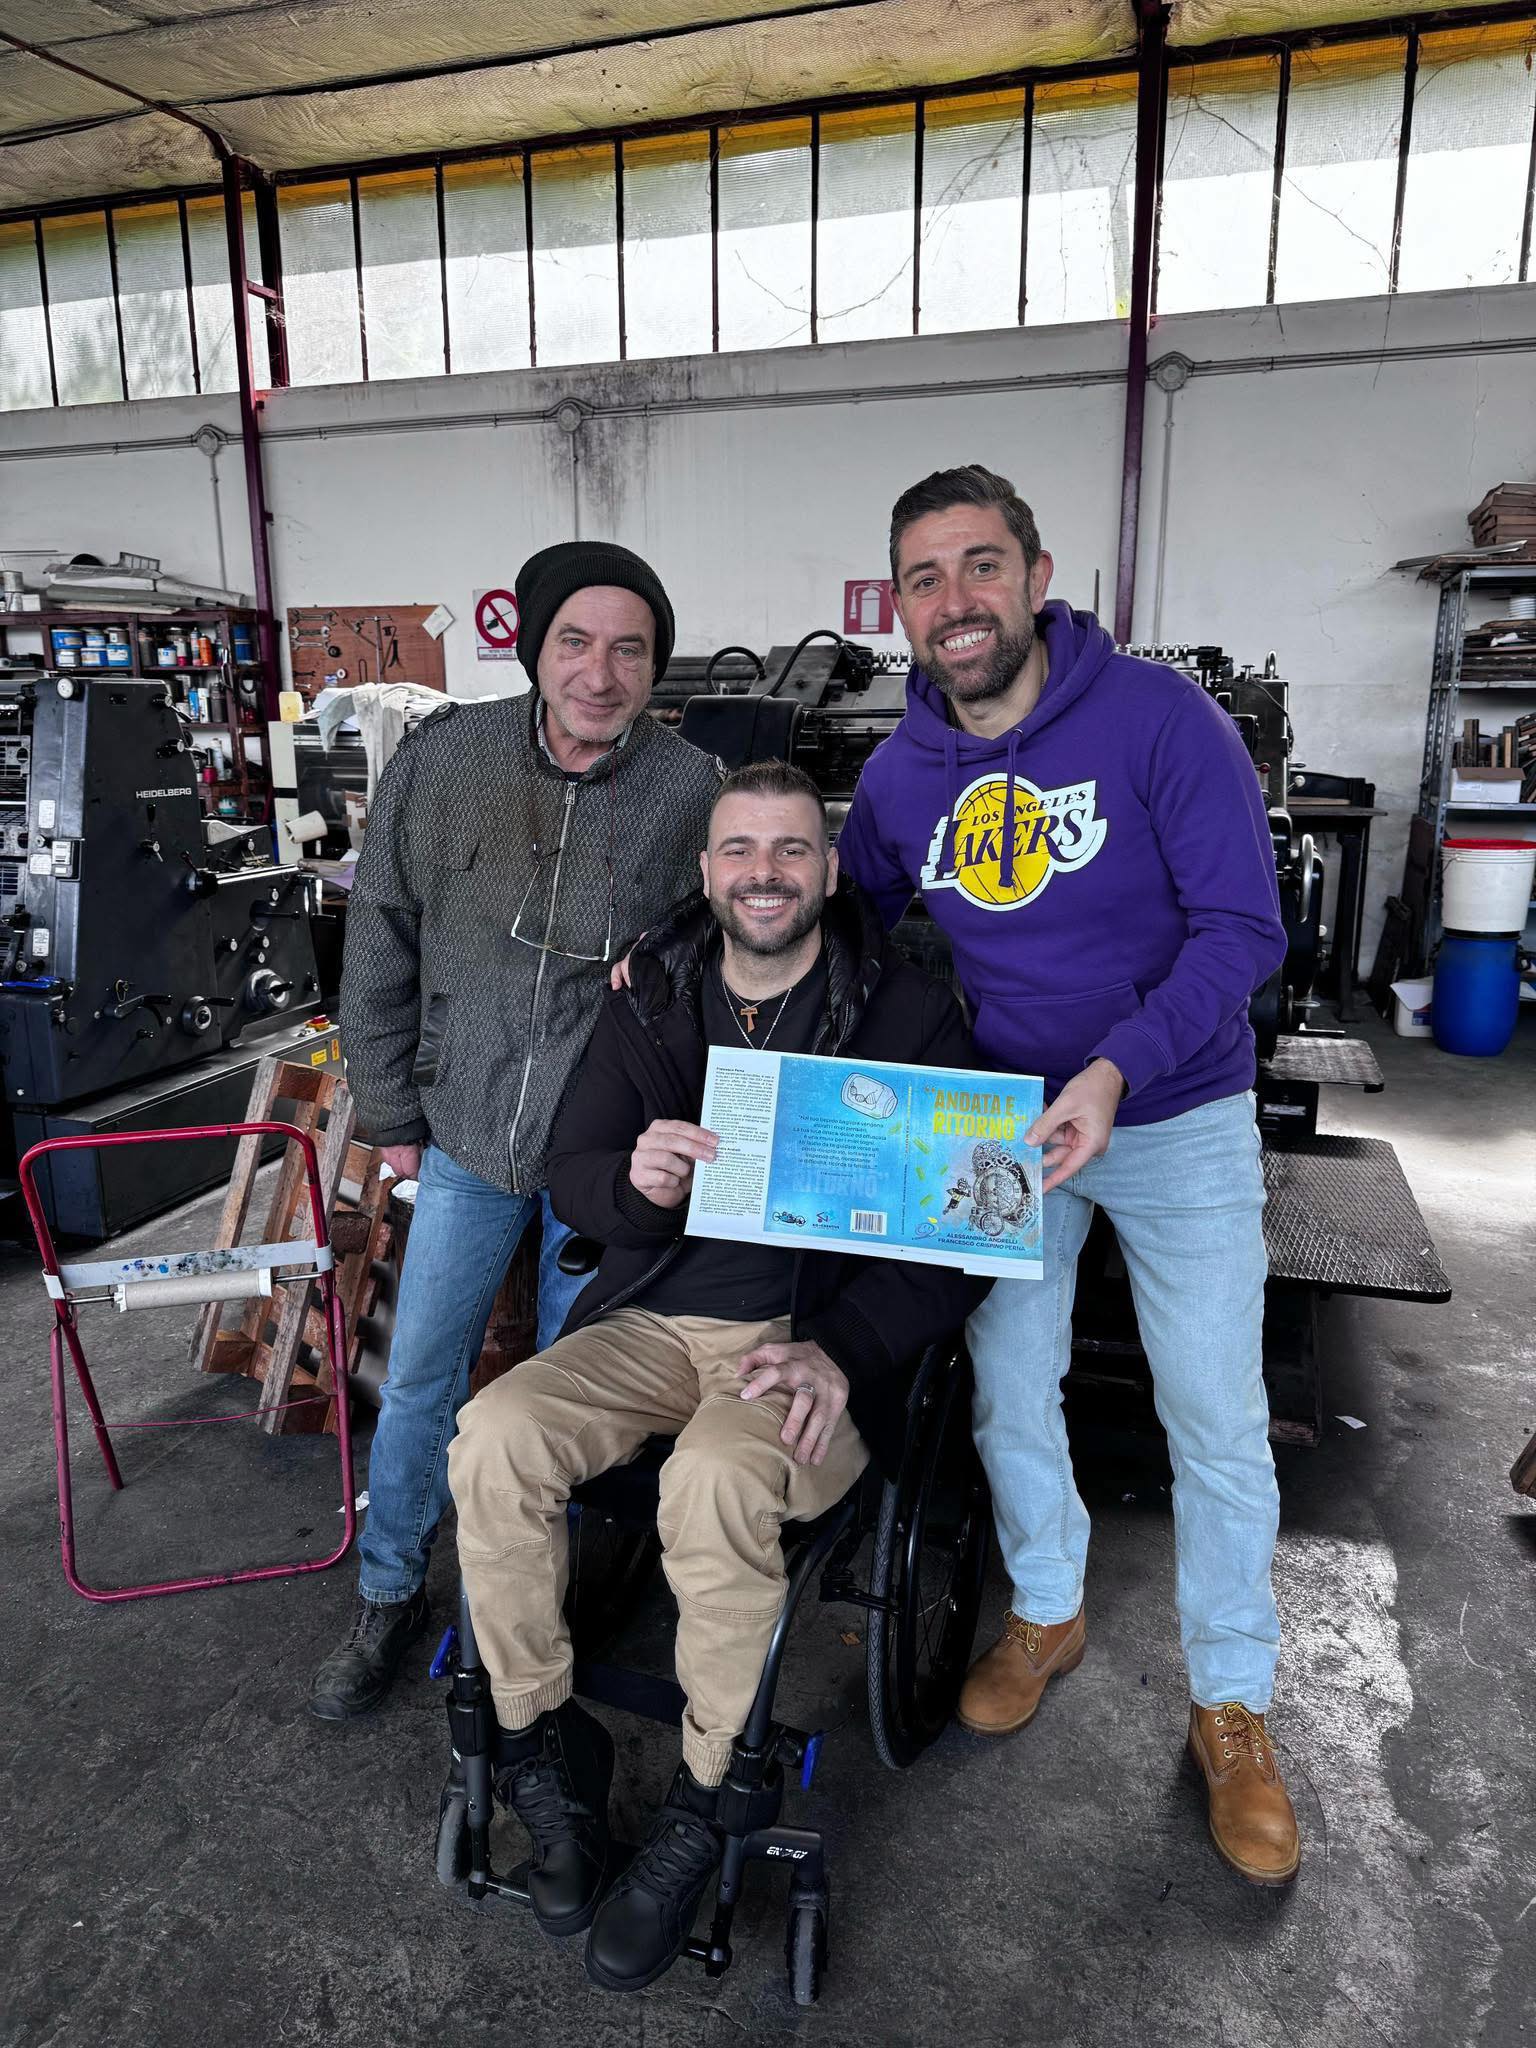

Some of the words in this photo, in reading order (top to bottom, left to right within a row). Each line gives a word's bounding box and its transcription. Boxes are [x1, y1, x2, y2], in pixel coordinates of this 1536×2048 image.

[136, 788, 192, 799] HEIDELBERG
[972, 810, 1000, 826] LOS
[1003, 789, 1088, 819] NGELES
[928, 808, 1097, 881] LAKERS
[1005, 1096, 1016, 1116] E
[938, 1238, 974, 1246] FRANCESCO
[947, 1232, 987, 1242] ALESSANDRO
